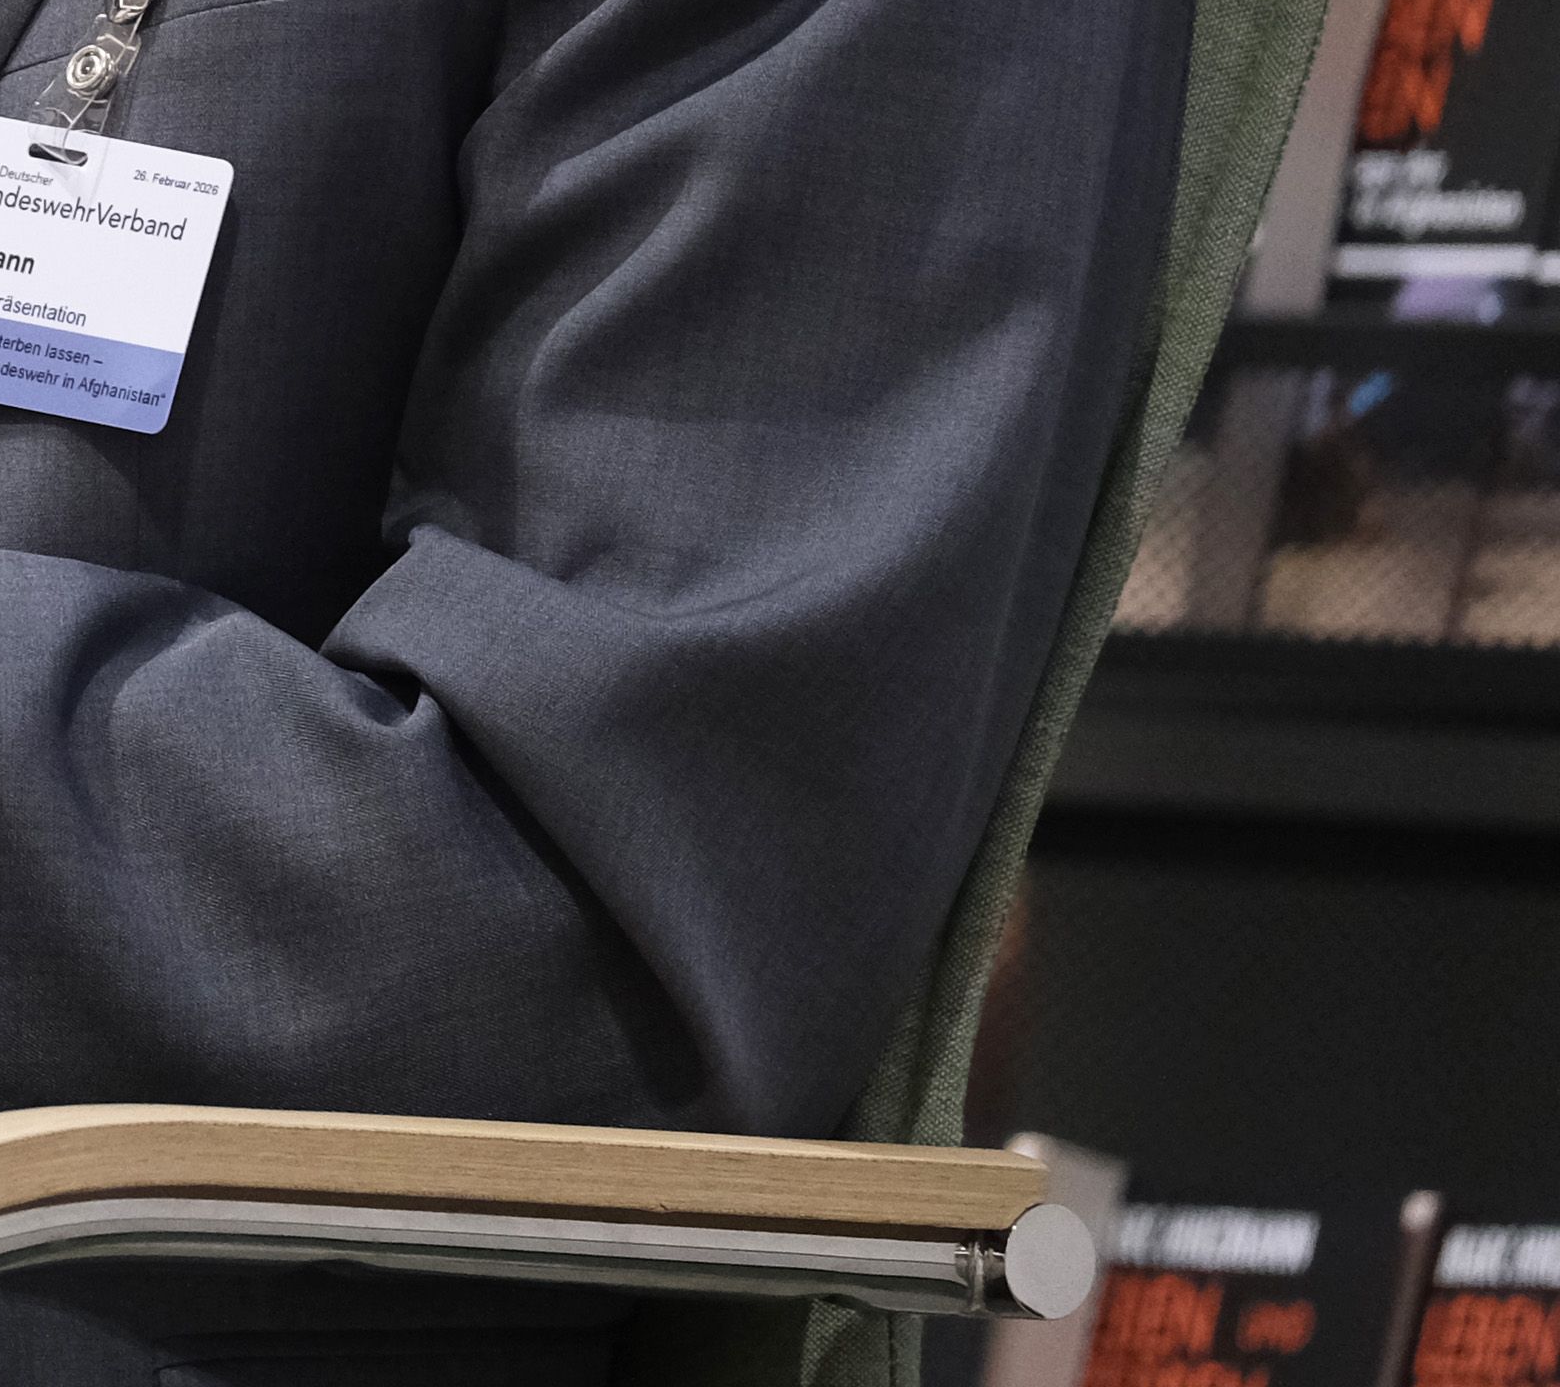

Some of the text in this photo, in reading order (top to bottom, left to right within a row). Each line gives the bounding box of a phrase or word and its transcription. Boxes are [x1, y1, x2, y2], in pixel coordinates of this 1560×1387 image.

[151, 172, 192, 192] Februar
[44, 342, 91, 367] lassen
[63, 371, 75, 389] in
